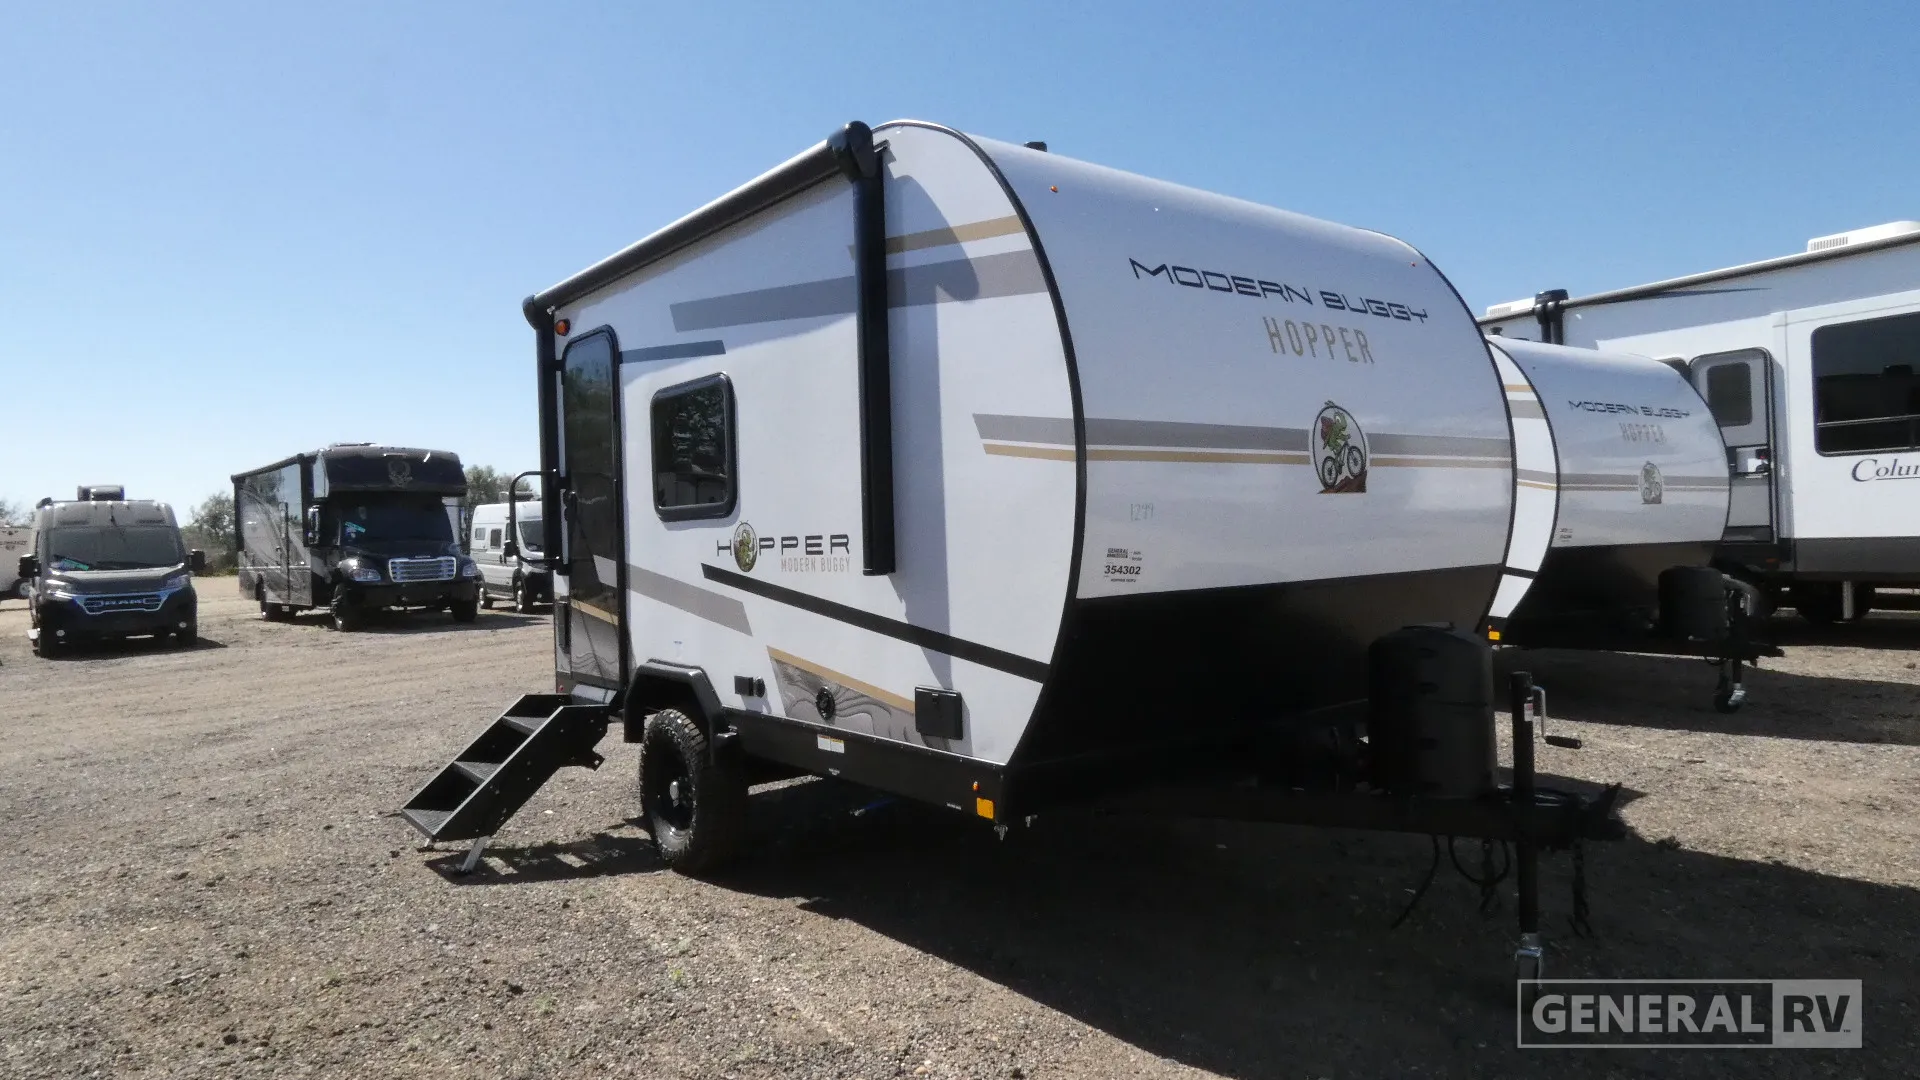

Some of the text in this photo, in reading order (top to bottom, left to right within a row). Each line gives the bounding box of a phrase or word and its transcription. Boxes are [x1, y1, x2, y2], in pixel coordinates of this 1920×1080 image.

[1129, 258, 1428, 323] MODERN BUGGY
[1263, 316, 1375, 364] HOPPER
[1568, 400, 1690, 419] MODERN BUGGY
[781, 557, 851, 573] MODERN BUGGY
[1104, 565, 1141, 575] 354302
